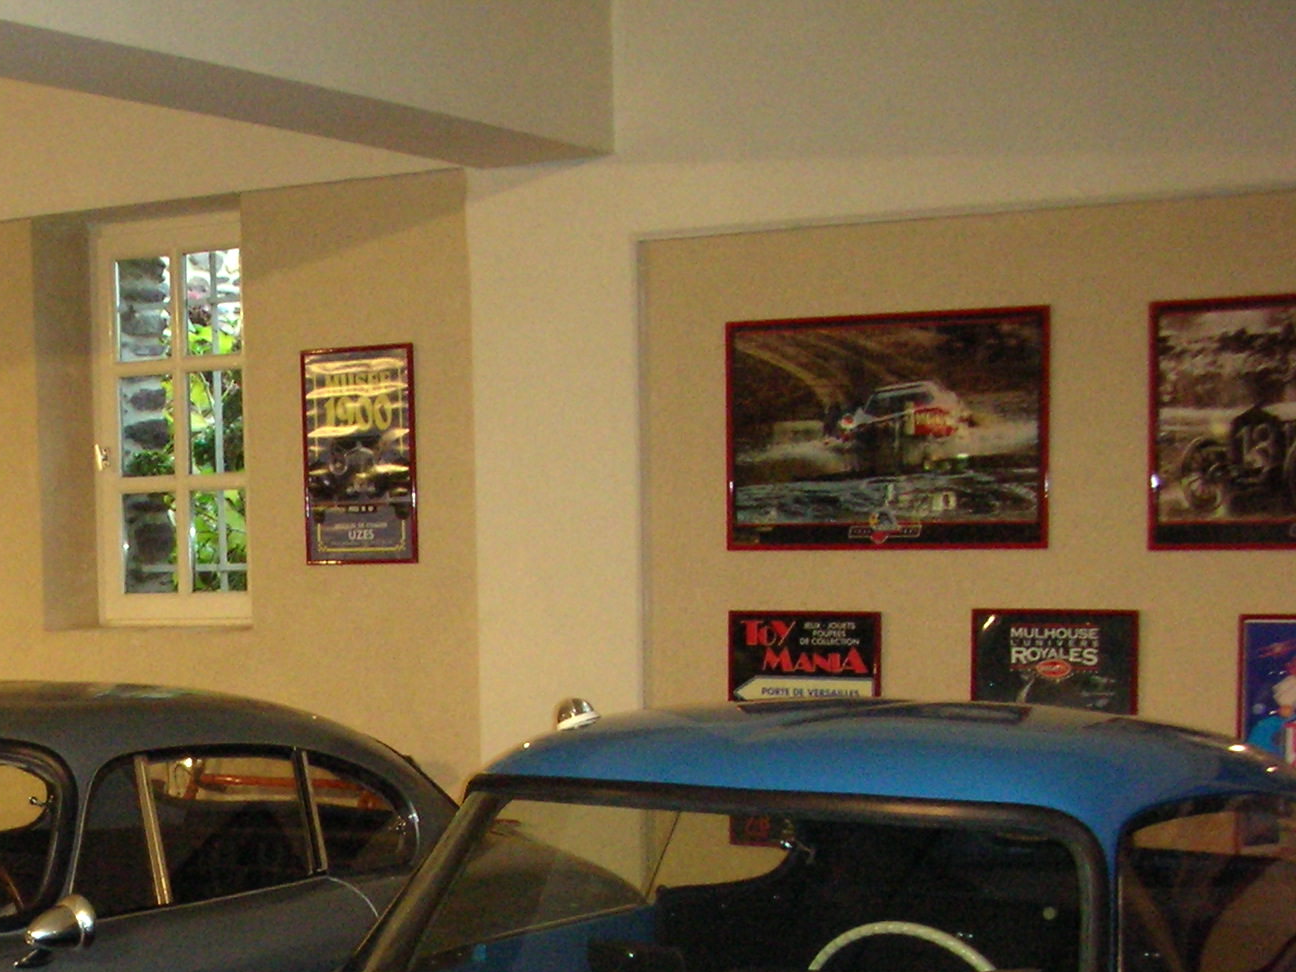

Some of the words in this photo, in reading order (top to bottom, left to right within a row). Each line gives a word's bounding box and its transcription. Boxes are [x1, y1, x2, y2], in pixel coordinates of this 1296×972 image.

[325, 395, 392, 430] 1900
[1010, 628, 1100, 639] MULHOUSE
[800, 638, 809, 646] DE
[811, 638, 860, 646] COLLECTION
[762, 646, 869, 674] MANIA
[1010, 647, 1098, 666] ROYALES
[761, 687, 789, 696] PORTE
[793, 688, 804, 696] DE
[807, 688, 860, 697] VERSAILLES
